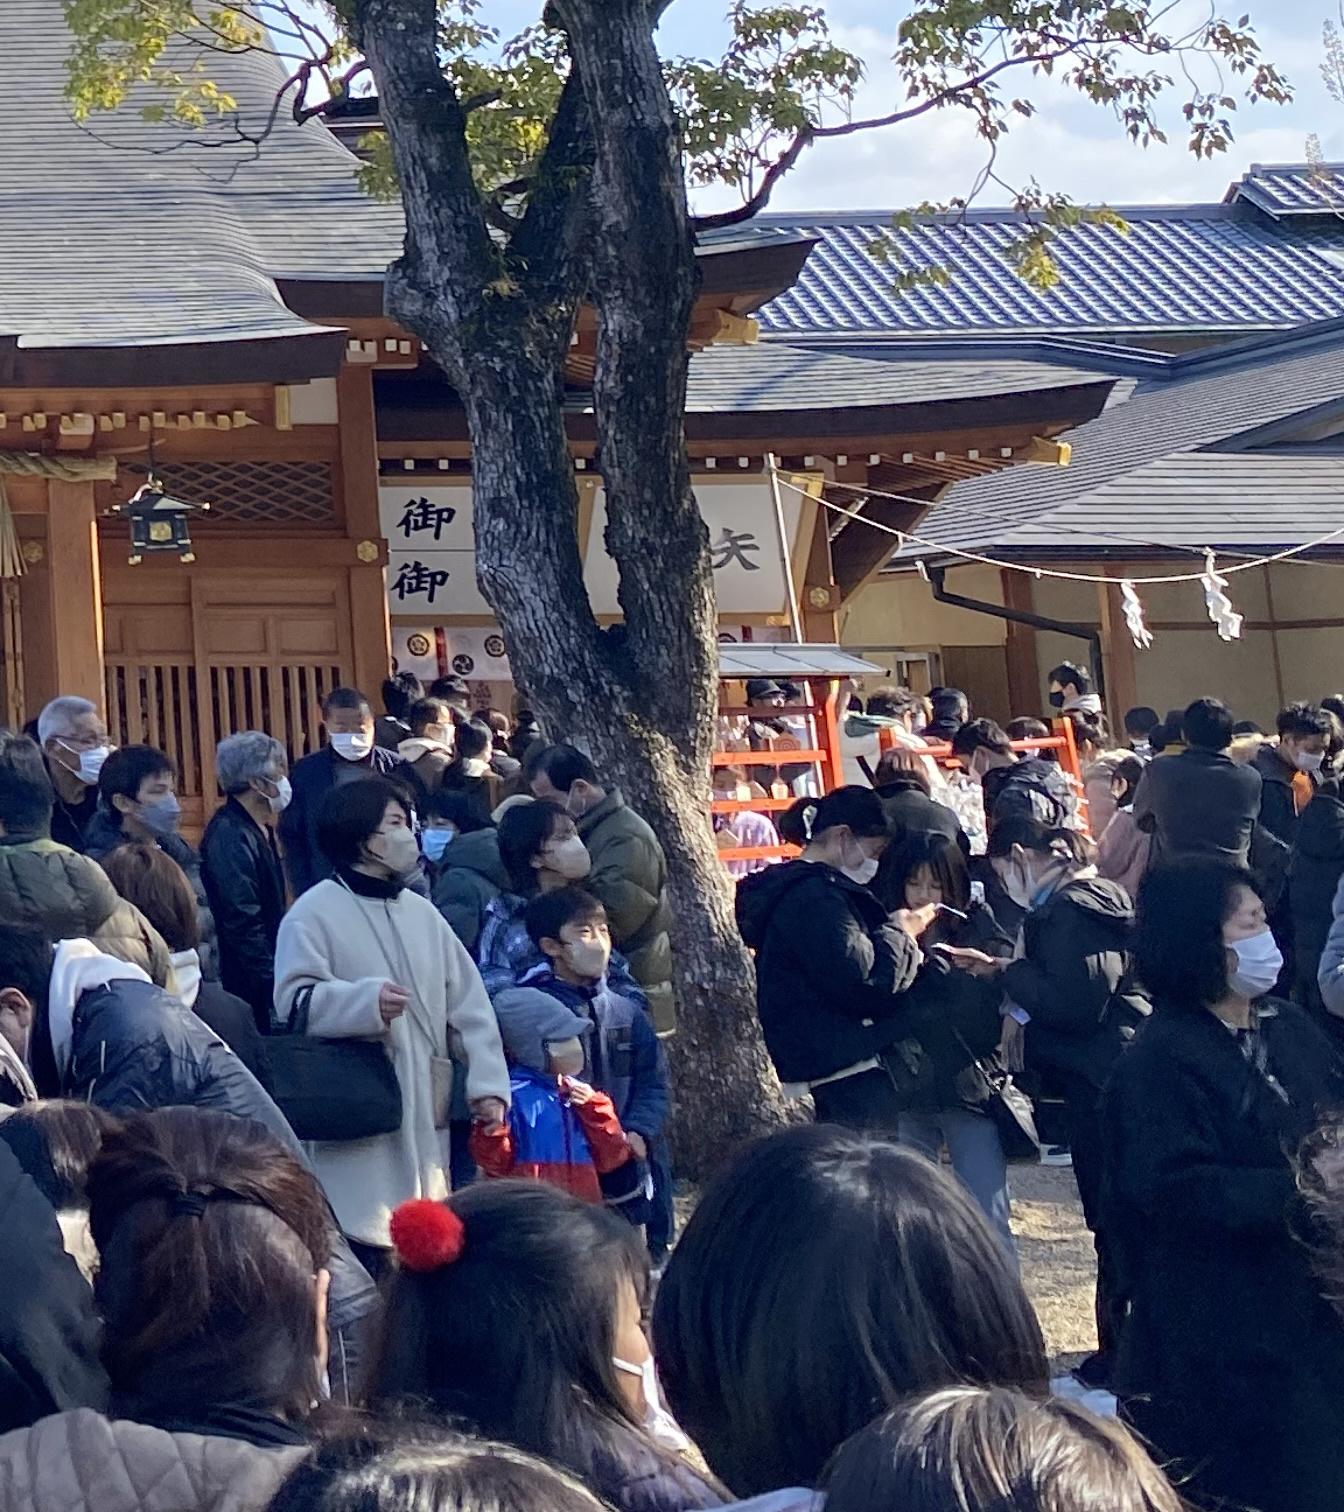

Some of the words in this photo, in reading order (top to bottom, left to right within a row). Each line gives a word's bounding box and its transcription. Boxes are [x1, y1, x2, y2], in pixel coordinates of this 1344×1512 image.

[396, 496, 456, 541] 御
[711, 527, 760, 571] 矢
[390, 560, 450, 603] 御
